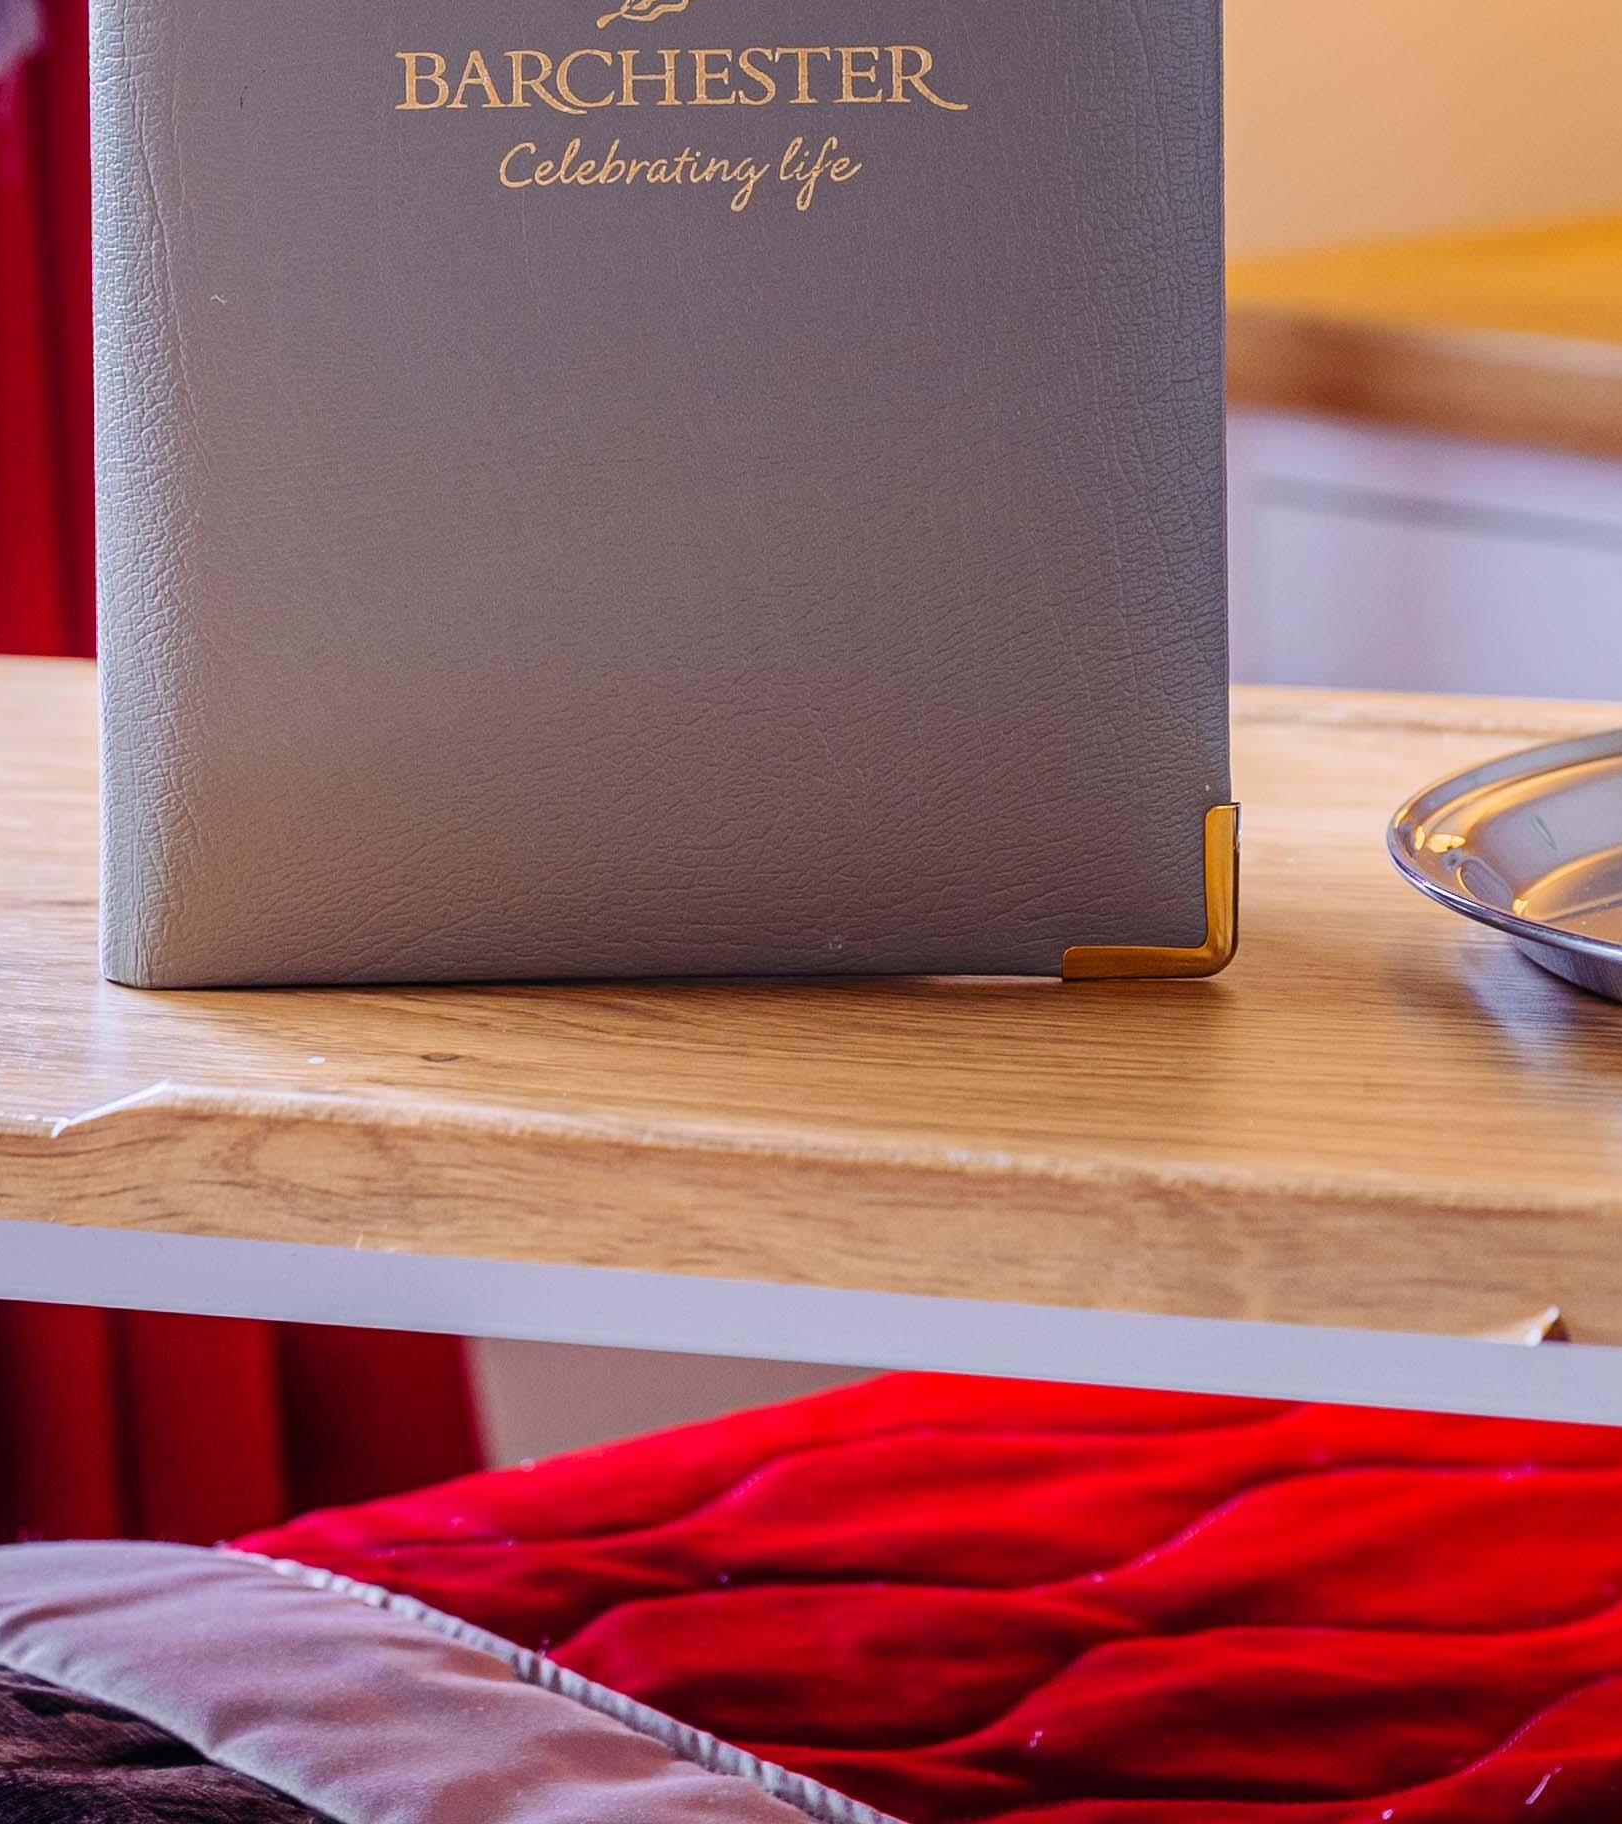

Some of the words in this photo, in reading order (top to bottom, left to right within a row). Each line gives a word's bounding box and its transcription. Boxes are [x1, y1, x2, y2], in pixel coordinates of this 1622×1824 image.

[394, 44, 969, 114] BARCHESTER
[499, 137, 770, 212] Celebrating
[778, 135, 863, 212] life
